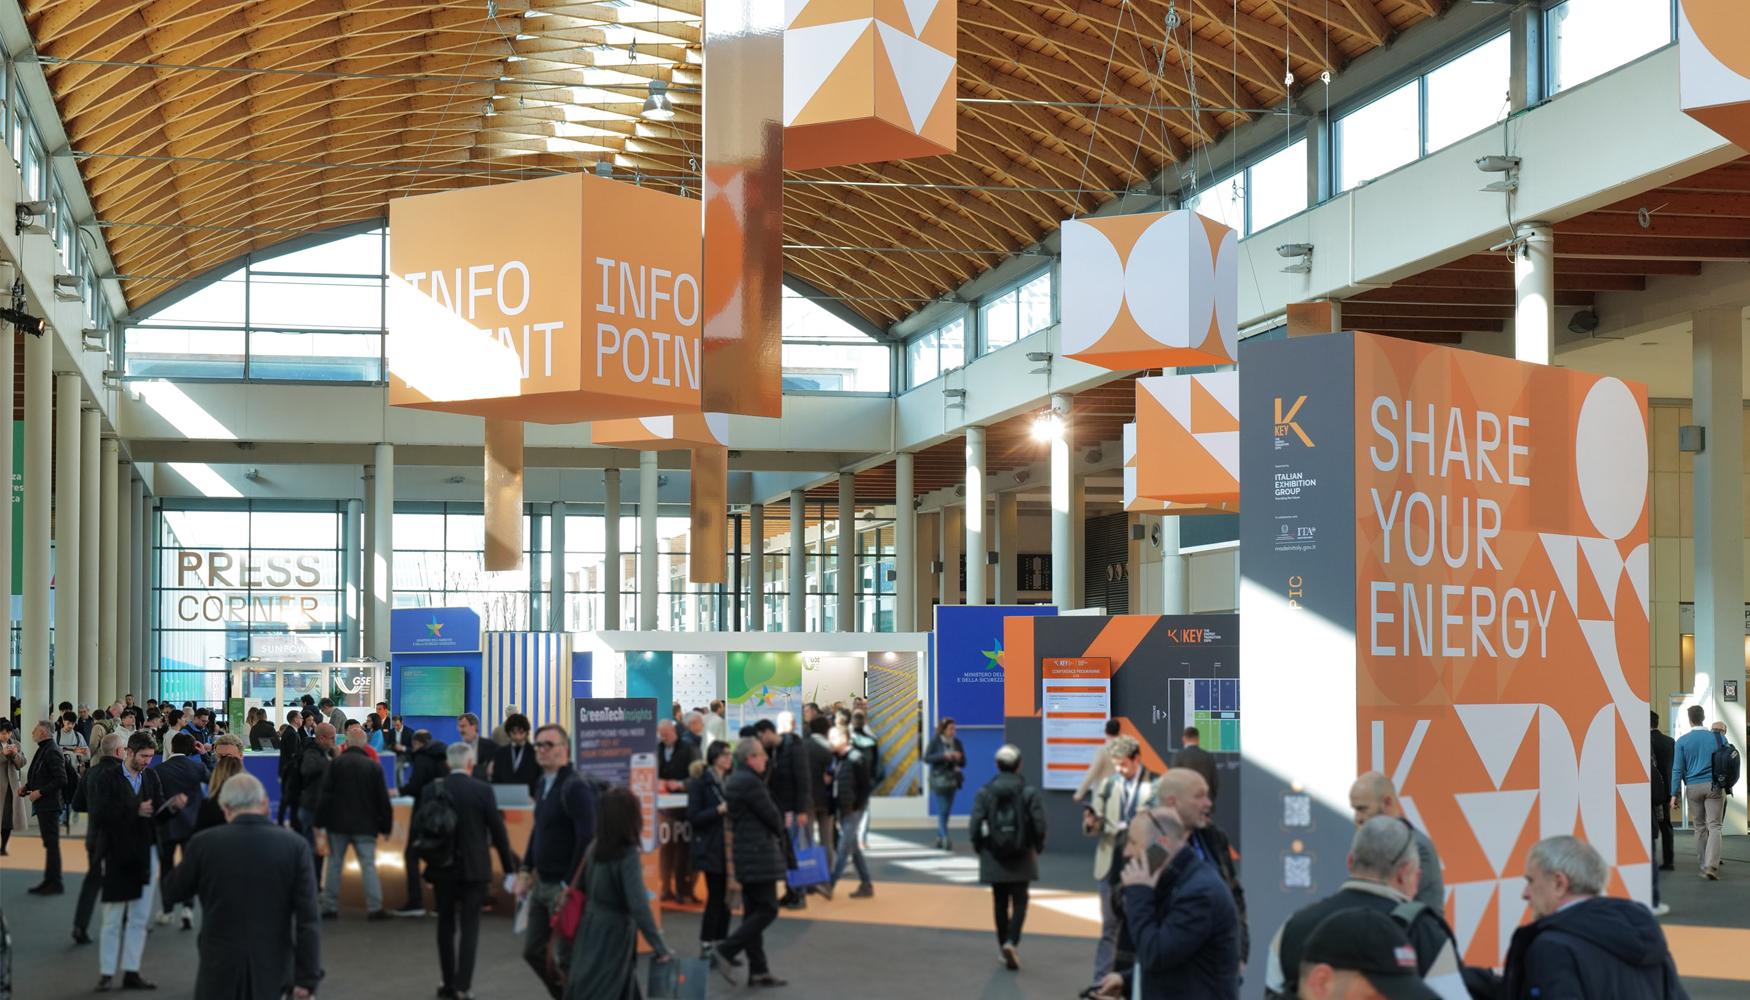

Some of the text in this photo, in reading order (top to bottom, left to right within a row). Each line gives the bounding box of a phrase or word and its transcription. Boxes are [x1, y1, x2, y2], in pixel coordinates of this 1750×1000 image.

[596, 256, 699, 327] INFO
[597, 323, 700, 390] POIN
[1274, 425, 1290, 437] KEY
[1370, 395, 1531, 487] SHARE
[1274, 472, 1303, 481] ITALIAN
[1274, 479, 1317, 489] EXHIBITION
[1274, 488, 1301, 496] GROUP
[1370, 488, 1504, 570] YOUR
[177, 551, 321, 588] PRESS
[178, 595, 319, 623] CORNER
[1370, 581, 1556, 658] ENERGY
[1182, 629, 1203, 643] KEY
[352, 676, 371, 685] GSE
[580, 707, 653, 723] GreenTechInsights
